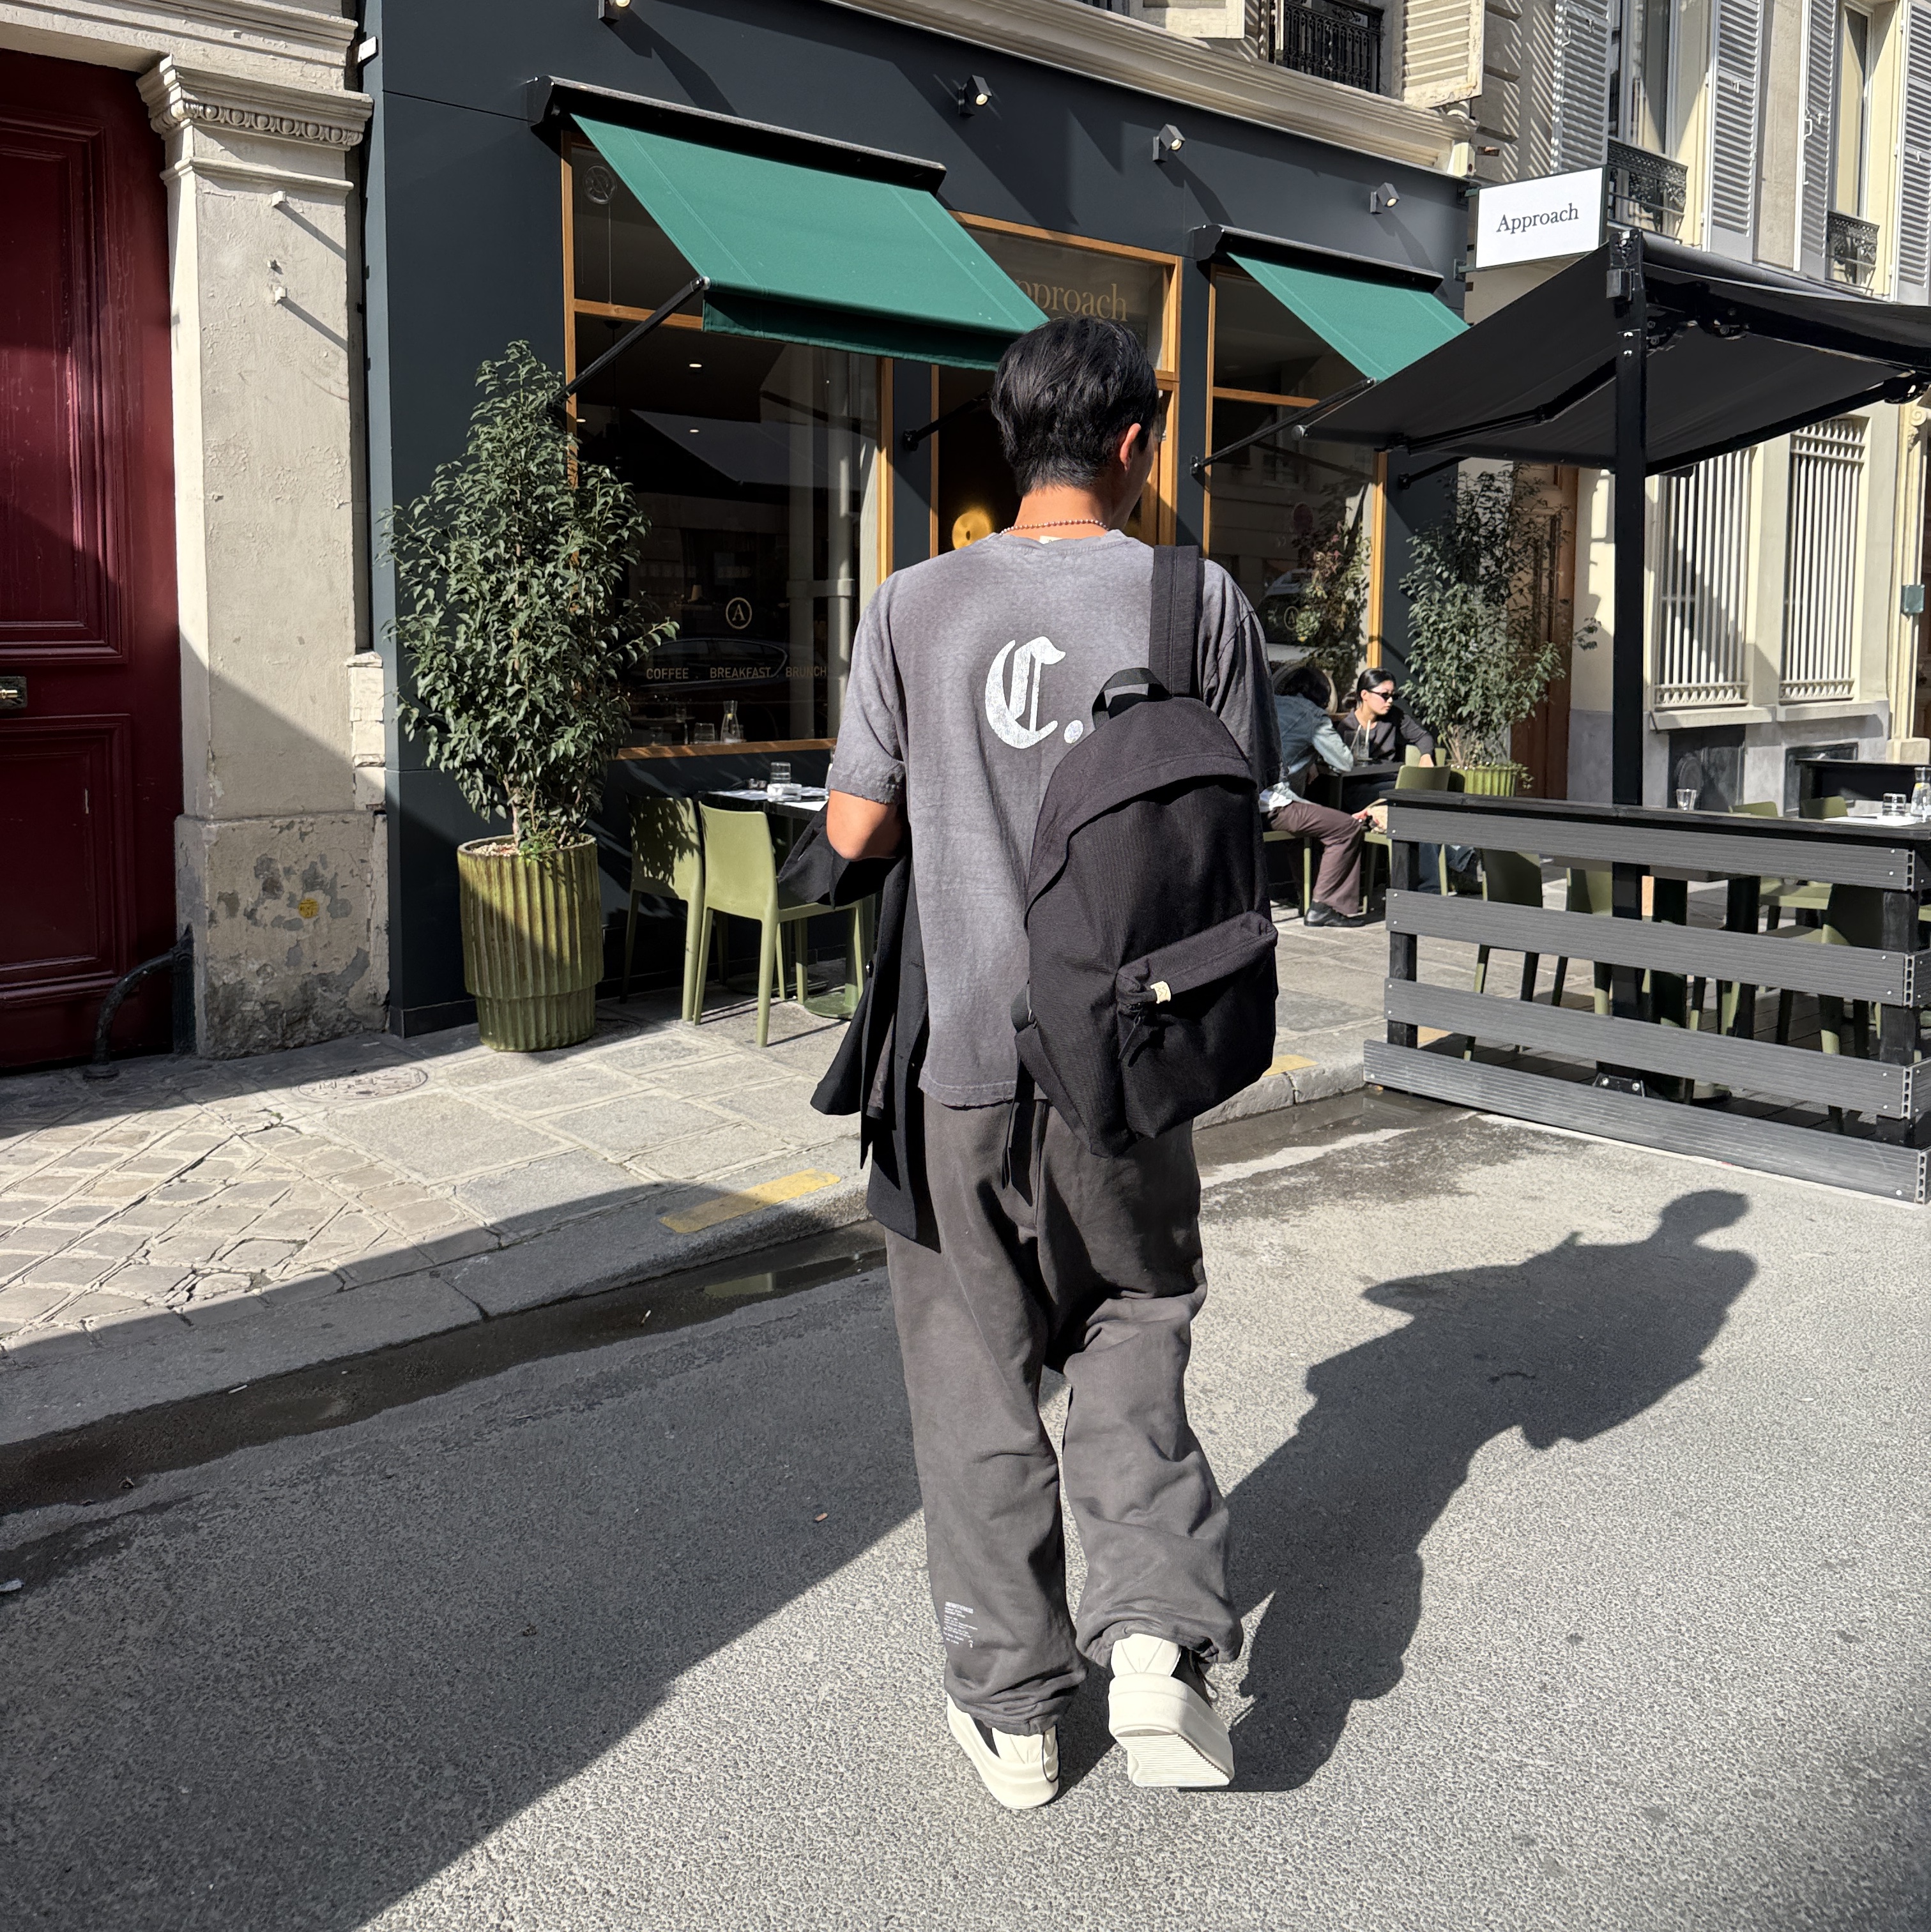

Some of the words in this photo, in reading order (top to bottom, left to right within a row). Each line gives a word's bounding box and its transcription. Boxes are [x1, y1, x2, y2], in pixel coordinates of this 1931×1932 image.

[1496, 202, 1579, 234] Approach
[1015, 279, 1127, 321] proach
[732, 604, 745, 621] A
[646, 667, 689, 680] COFFEE
[710, 667, 771, 678] BREAKFAST
[786, 666, 827, 678] BRUNCH
